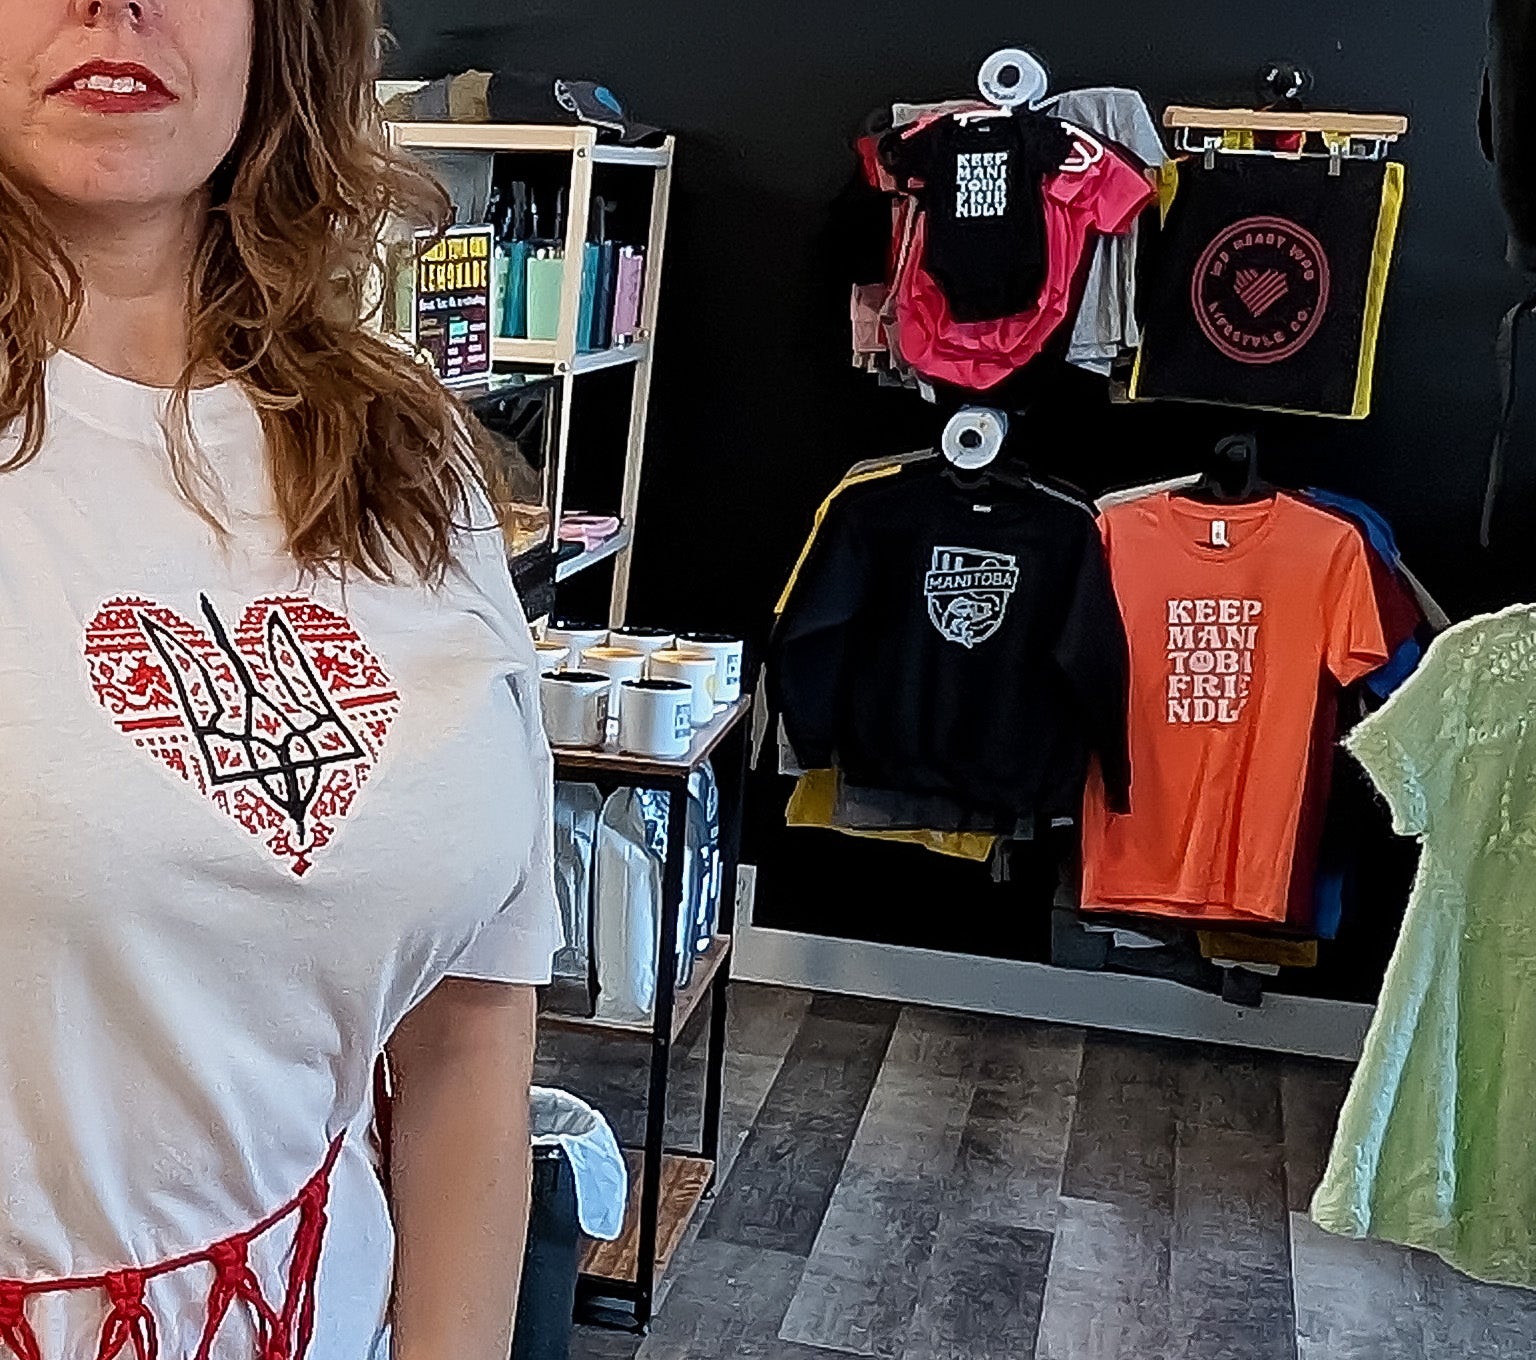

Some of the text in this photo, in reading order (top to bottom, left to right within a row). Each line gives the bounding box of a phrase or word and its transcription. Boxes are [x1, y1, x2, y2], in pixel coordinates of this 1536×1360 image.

[956, 152, 1008, 167] KEEP
[956, 165, 1007, 180] MANI
[955, 202, 1007, 218] NDLY
[928, 572, 1013, 590] MANITOBA
[1167, 599, 1263, 624] KEEP
[1166, 625, 1259, 650] MANI
